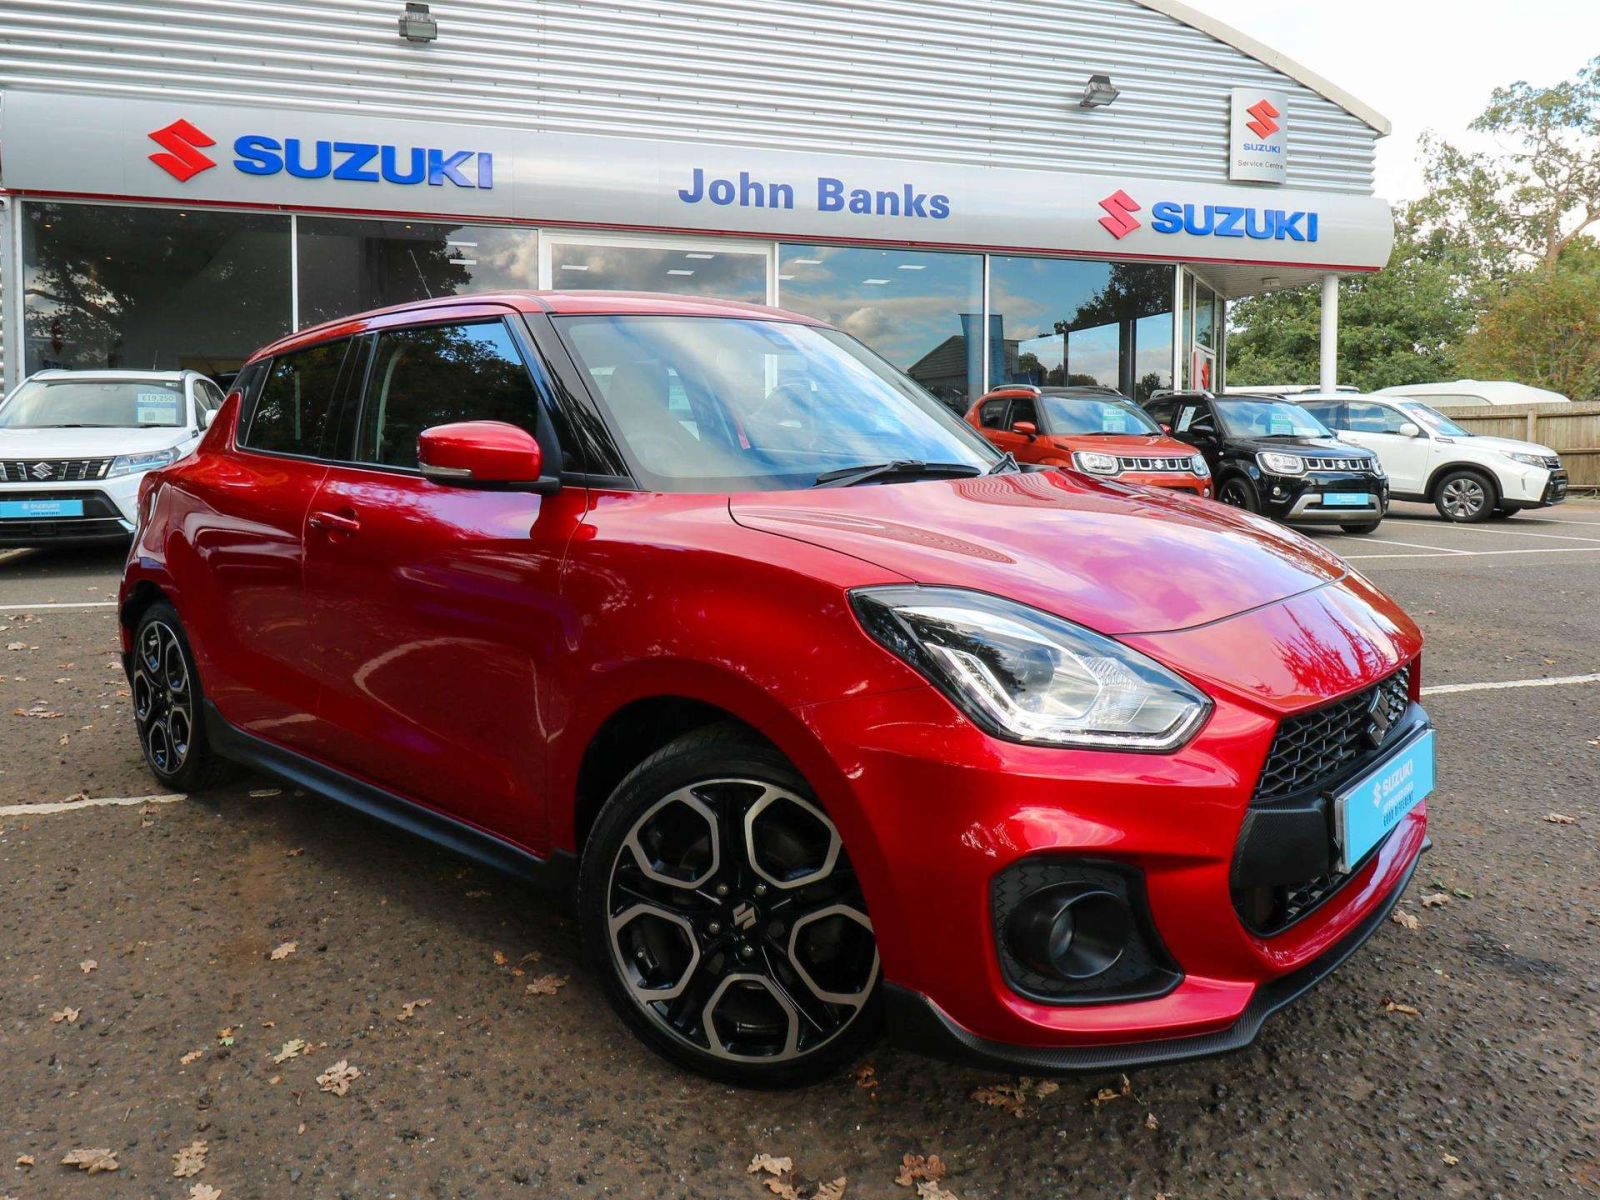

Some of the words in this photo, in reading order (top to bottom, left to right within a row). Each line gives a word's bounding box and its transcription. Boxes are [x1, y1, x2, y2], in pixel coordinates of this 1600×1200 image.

[233, 135, 493, 190] SUZUKI
[1237, 160, 1263, 168] Service
[1264, 161, 1284, 170] Centre
[1243, 143, 1281, 153] SUZUKI
[678, 168, 794, 209] John
[817, 177, 950, 220] Banks
[1151, 201, 1318, 243] SUZUKI
[1382, 758, 1414, 797] SUZUKI
